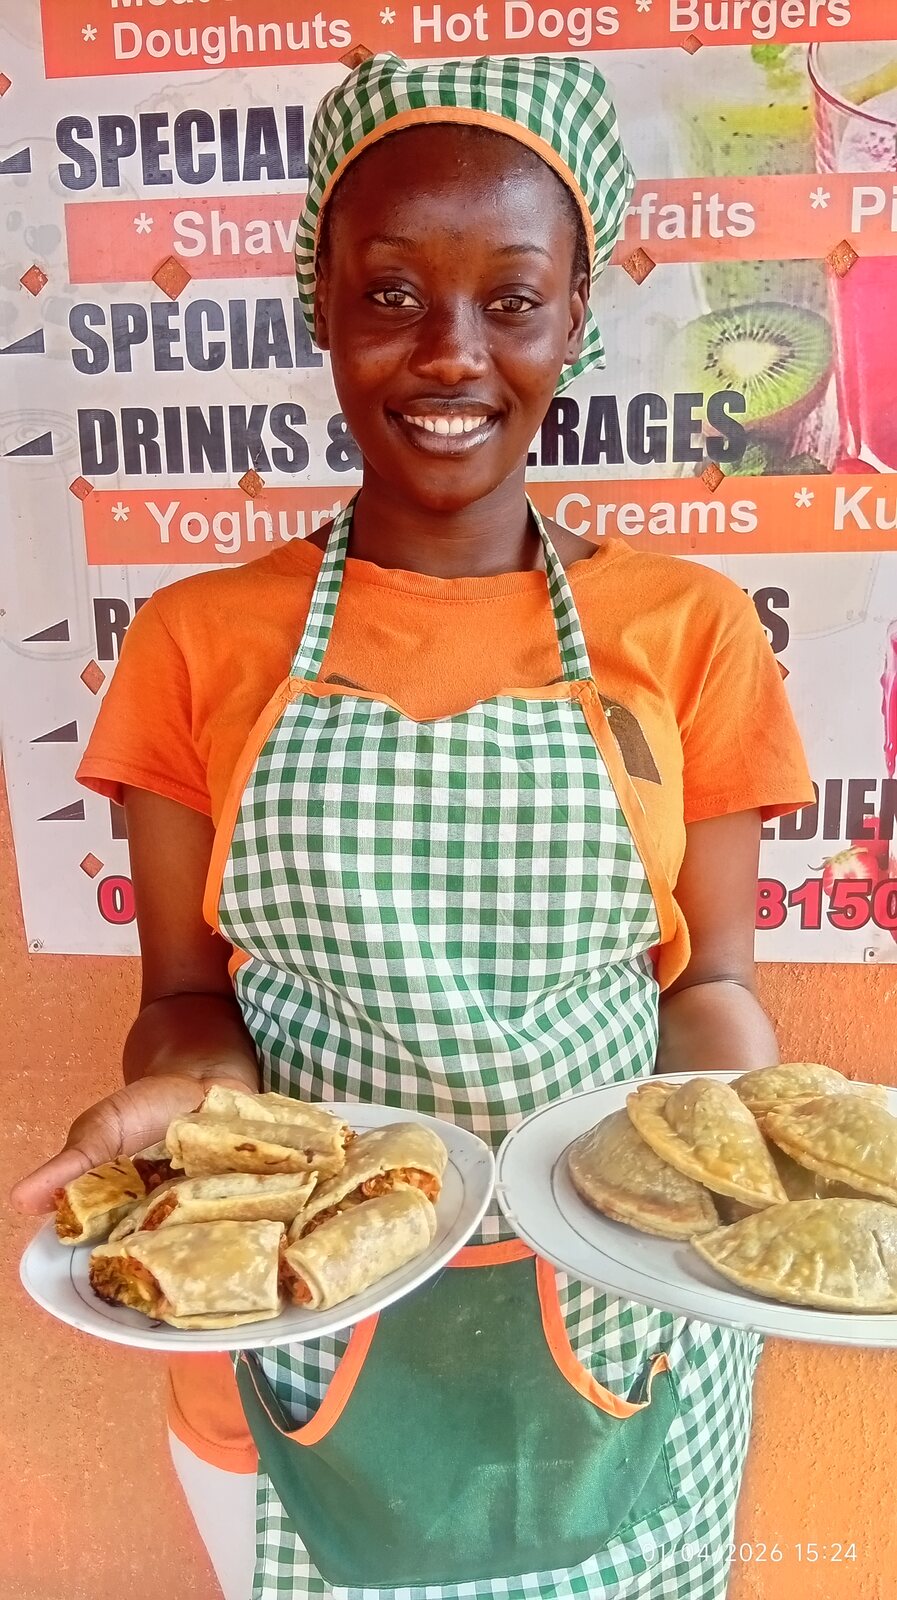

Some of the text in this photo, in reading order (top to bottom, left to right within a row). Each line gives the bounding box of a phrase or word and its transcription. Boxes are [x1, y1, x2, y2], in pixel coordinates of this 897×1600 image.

[113, 0, 852, 65] Doughnuts Hot Dogs Burgers
[55, 105, 309, 190] SPECIAL
[851, 186, 897, 233] Pi
[69, 298, 323, 375] SPECIAL
[77, 391, 747, 475] DRINKS & RAGES
[548, 493, 758, 536] Creams
[834, 486, 897, 530] Ku
